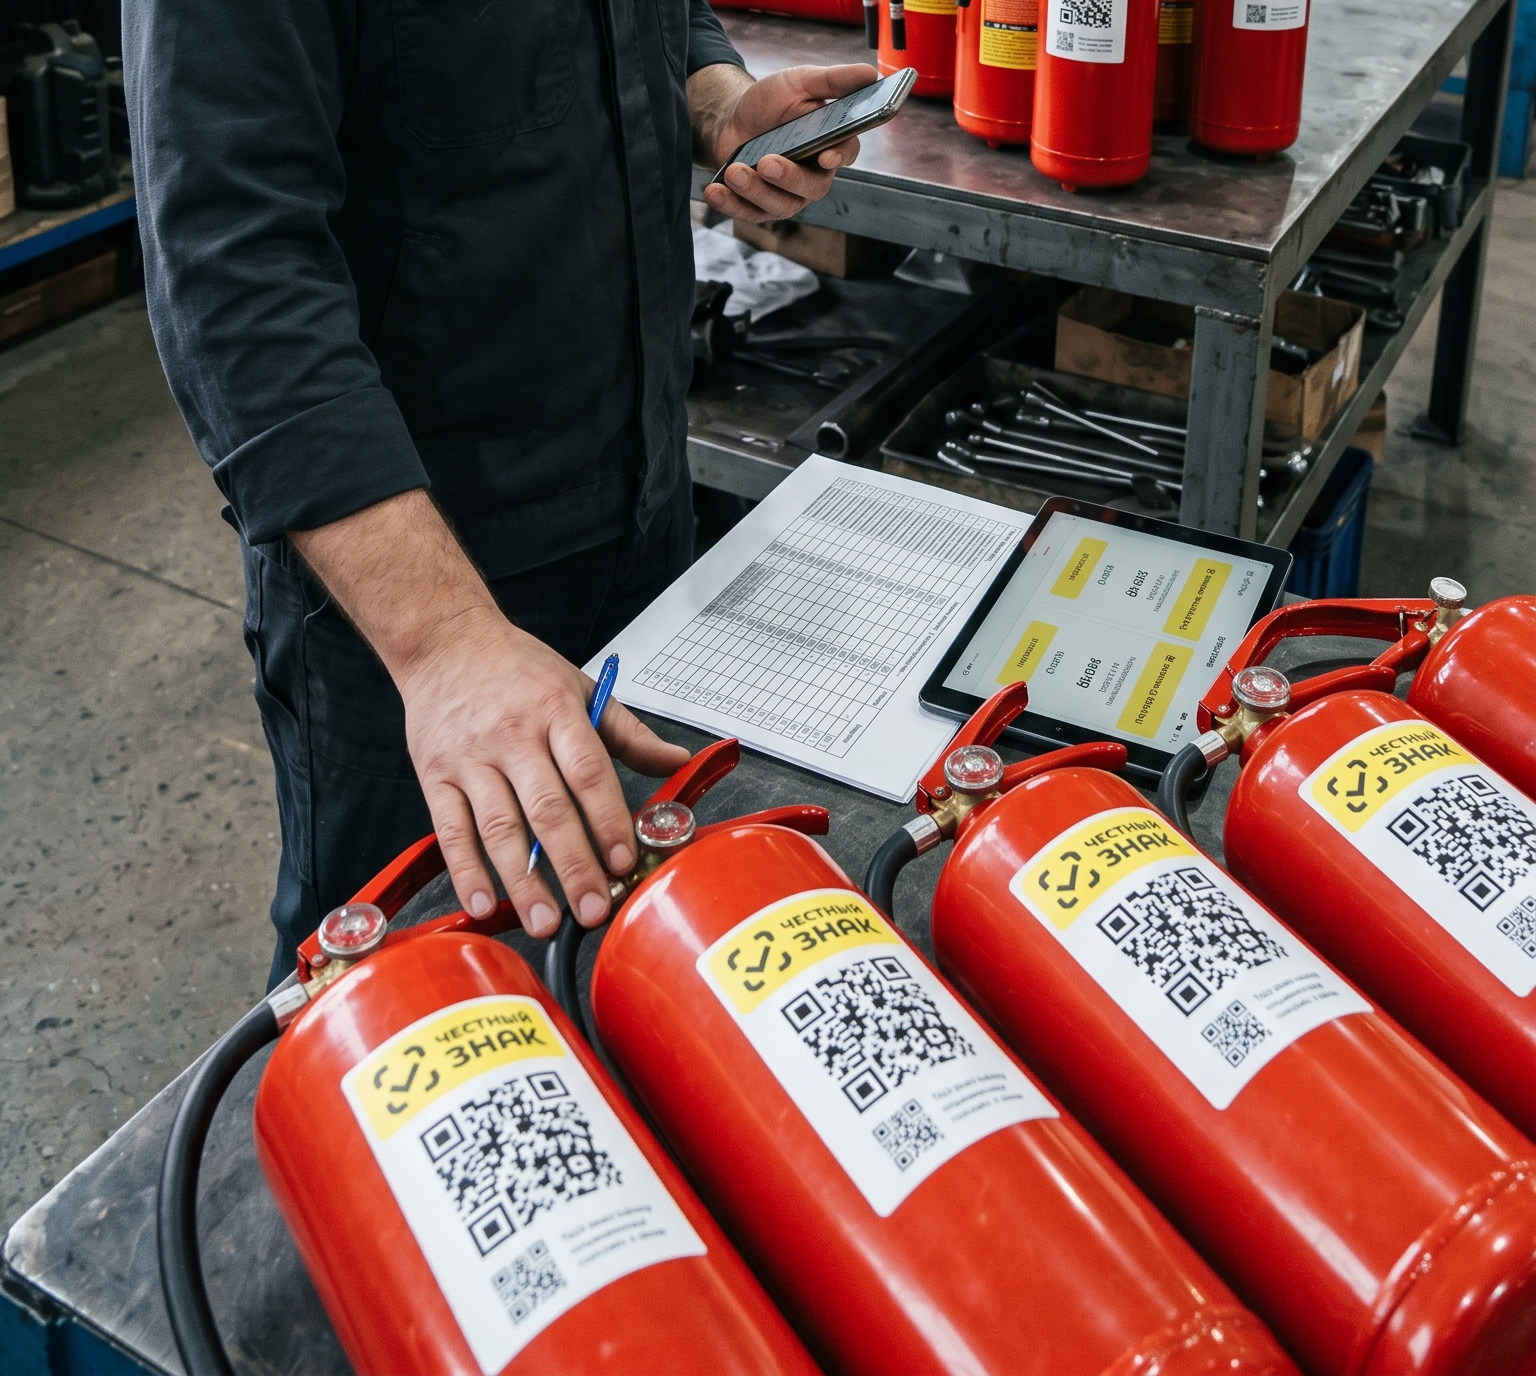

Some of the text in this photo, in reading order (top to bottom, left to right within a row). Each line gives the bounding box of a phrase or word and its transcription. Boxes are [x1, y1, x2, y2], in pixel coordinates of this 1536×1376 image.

[1369, 729, 1441, 758] ЧЕСТНЫЙ
[1383, 742, 1461, 775] ЗНАК
[1083, 819, 1161, 849] ЧЕСТНЫЙ
[1096, 831, 1180, 868] ЗНАК
[780, 903, 864, 931] ЧЕСТНЫЙ
[792, 917, 882, 952] ЗНАК
[434, 1010, 533, 1045] ЧЕСТНЫЙ
[445, 1027, 548, 1069] ЗНАК
